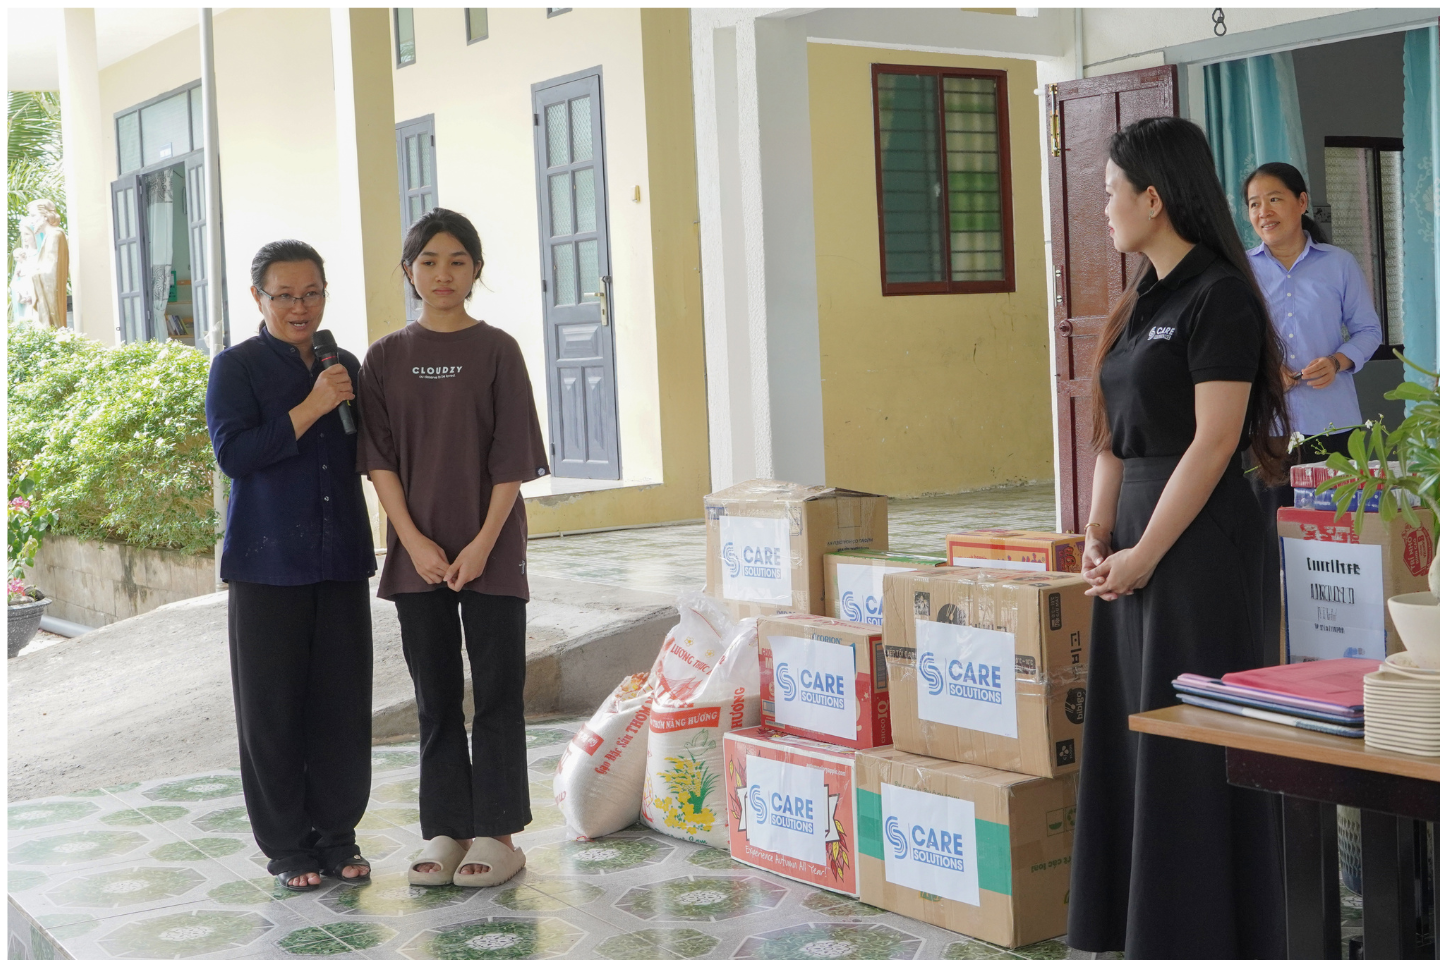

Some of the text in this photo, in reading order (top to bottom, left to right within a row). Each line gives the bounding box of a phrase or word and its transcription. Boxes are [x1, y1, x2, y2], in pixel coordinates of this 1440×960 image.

[1155, 326, 1176, 336] CARE
[412, 366, 463, 375] CLOUDZY
[743, 546, 781, 566] CARE
[744, 567, 781, 579] SOLUTIONS
[800, 670, 844, 695] CARE
[948, 659, 1002, 688] CARE
[801, 693, 845, 710] SOLUTIONS
[949, 684, 1002, 705] SOLUTIONS
[877, 699, 890, 719] IQ
[1076, 690, 1084, 721] bibigo
[771, 793, 814, 820] CARE
[771, 813, 814, 835] SOLUTIONS
[912, 825, 964, 856] CARE
[913, 848, 964, 872] SOLUTIONS
